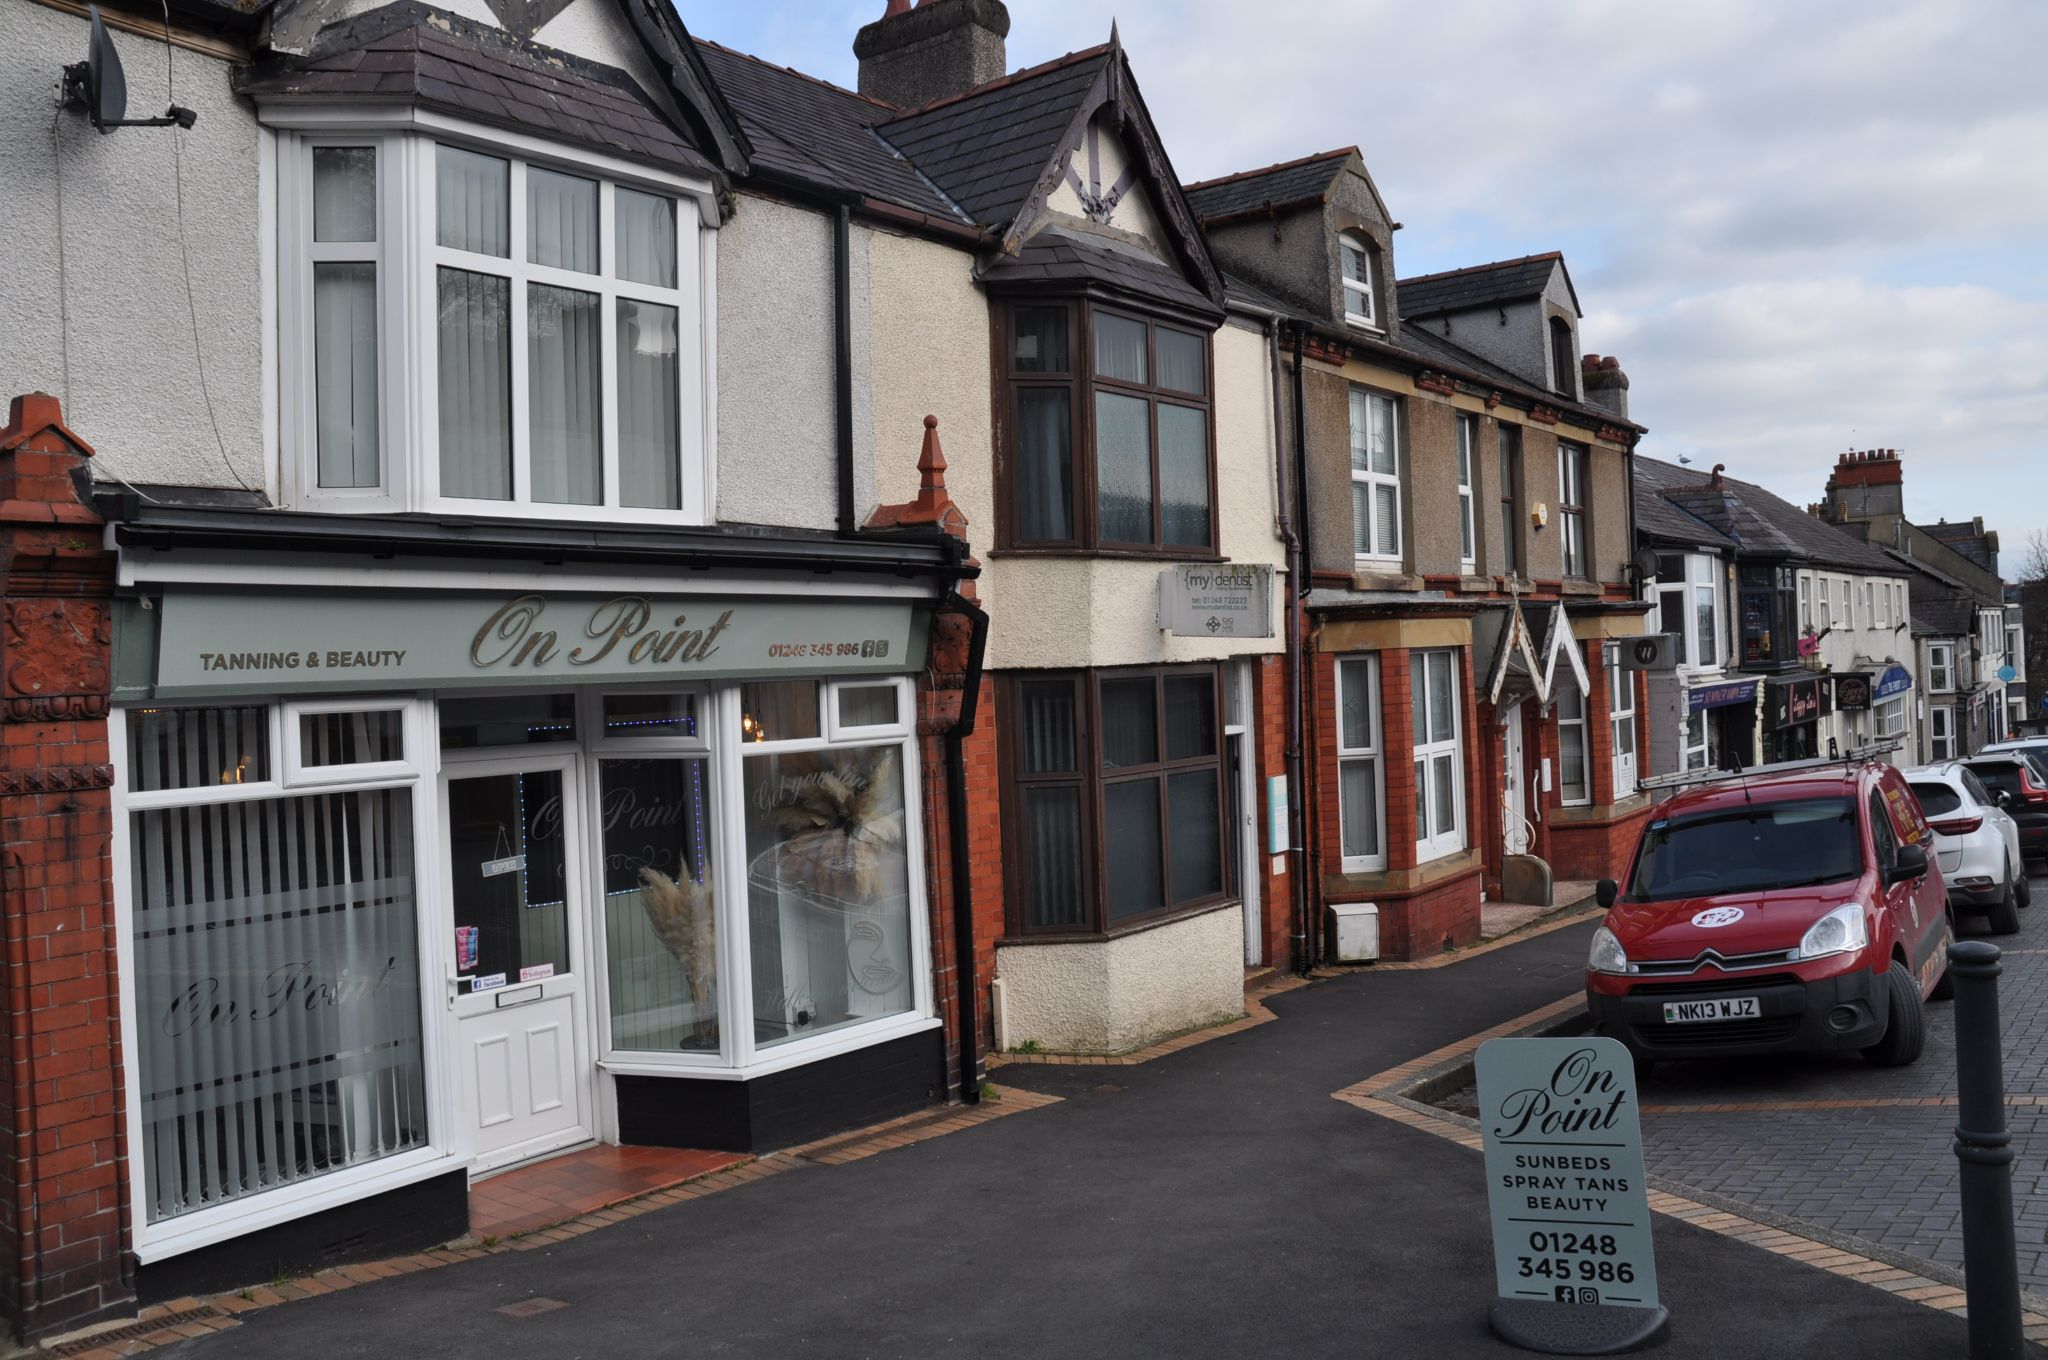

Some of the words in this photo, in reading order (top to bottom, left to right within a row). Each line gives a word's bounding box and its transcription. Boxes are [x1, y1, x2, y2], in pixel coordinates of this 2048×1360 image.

[470, 594, 560, 667] On
[568, 595, 734, 665] Point
[200, 652, 300, 671] TANNING
[306, 651, 320, 668] &
[326, 650, 406, 667] BEAUTY
[809, 643, 833, 656] 345
[836, 642, 859, 656] 986
[752, 775, 785, 819] Get
[1678, 1002, 1716, 1020] NK13
[1720, 999, 1755, 1017] WJZ
[1551, 1048, 1618, 1097] On
[1494, 1088, 1626, 1138] Point
[1516, 1155, 1611, 1171] SUNBEDS
[1503, 1175, 1566, 1190] SPRAY
[1575, 1177, 1629, 1192] TANS
[1527, 1196, 1608, 1212] BEAUTY
[1529, 1231, 1617, 1256] 01248
[1517, 1257, 1571, 1279] 345
[1578, 1260, 1635, 1283] 986
